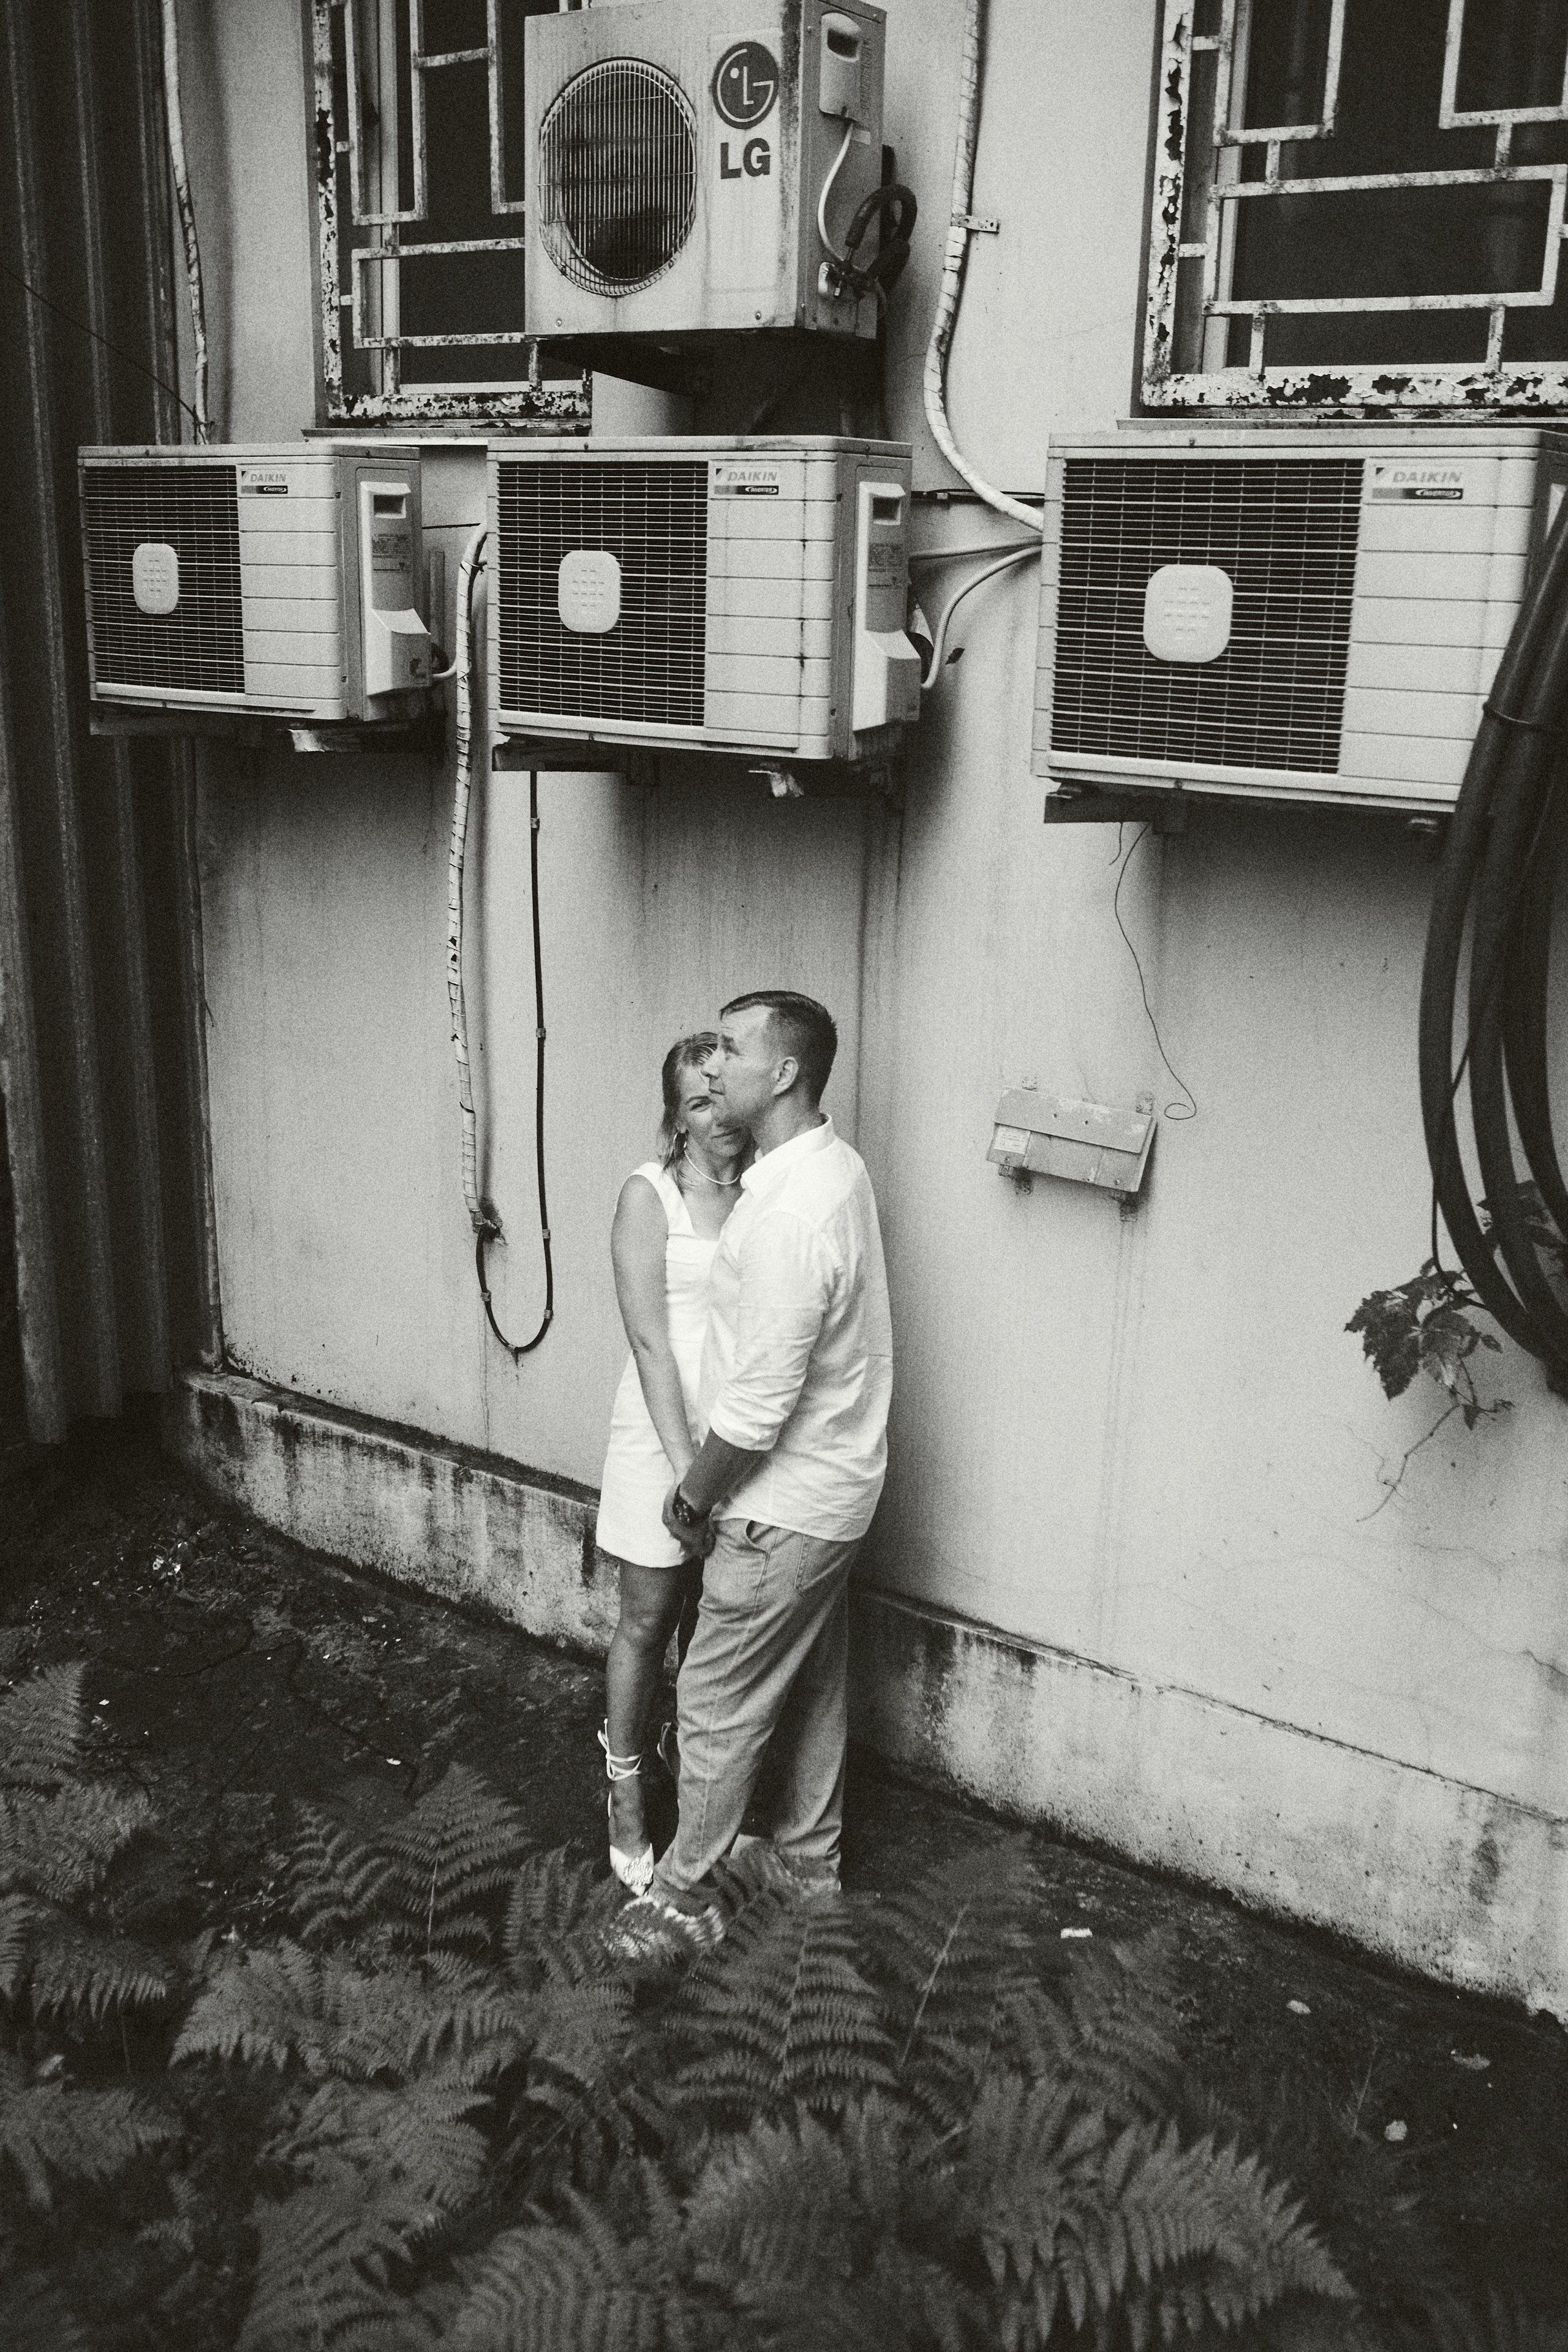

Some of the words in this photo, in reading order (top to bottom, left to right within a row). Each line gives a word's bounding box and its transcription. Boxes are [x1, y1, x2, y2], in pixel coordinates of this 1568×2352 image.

[720, 138, 771, 179] LG
[250, 473, 286, 482] DAIKIN
[728, 472, 777, 481] DAIKIN
[1392, 472, 1463, 483] DAIKIN
